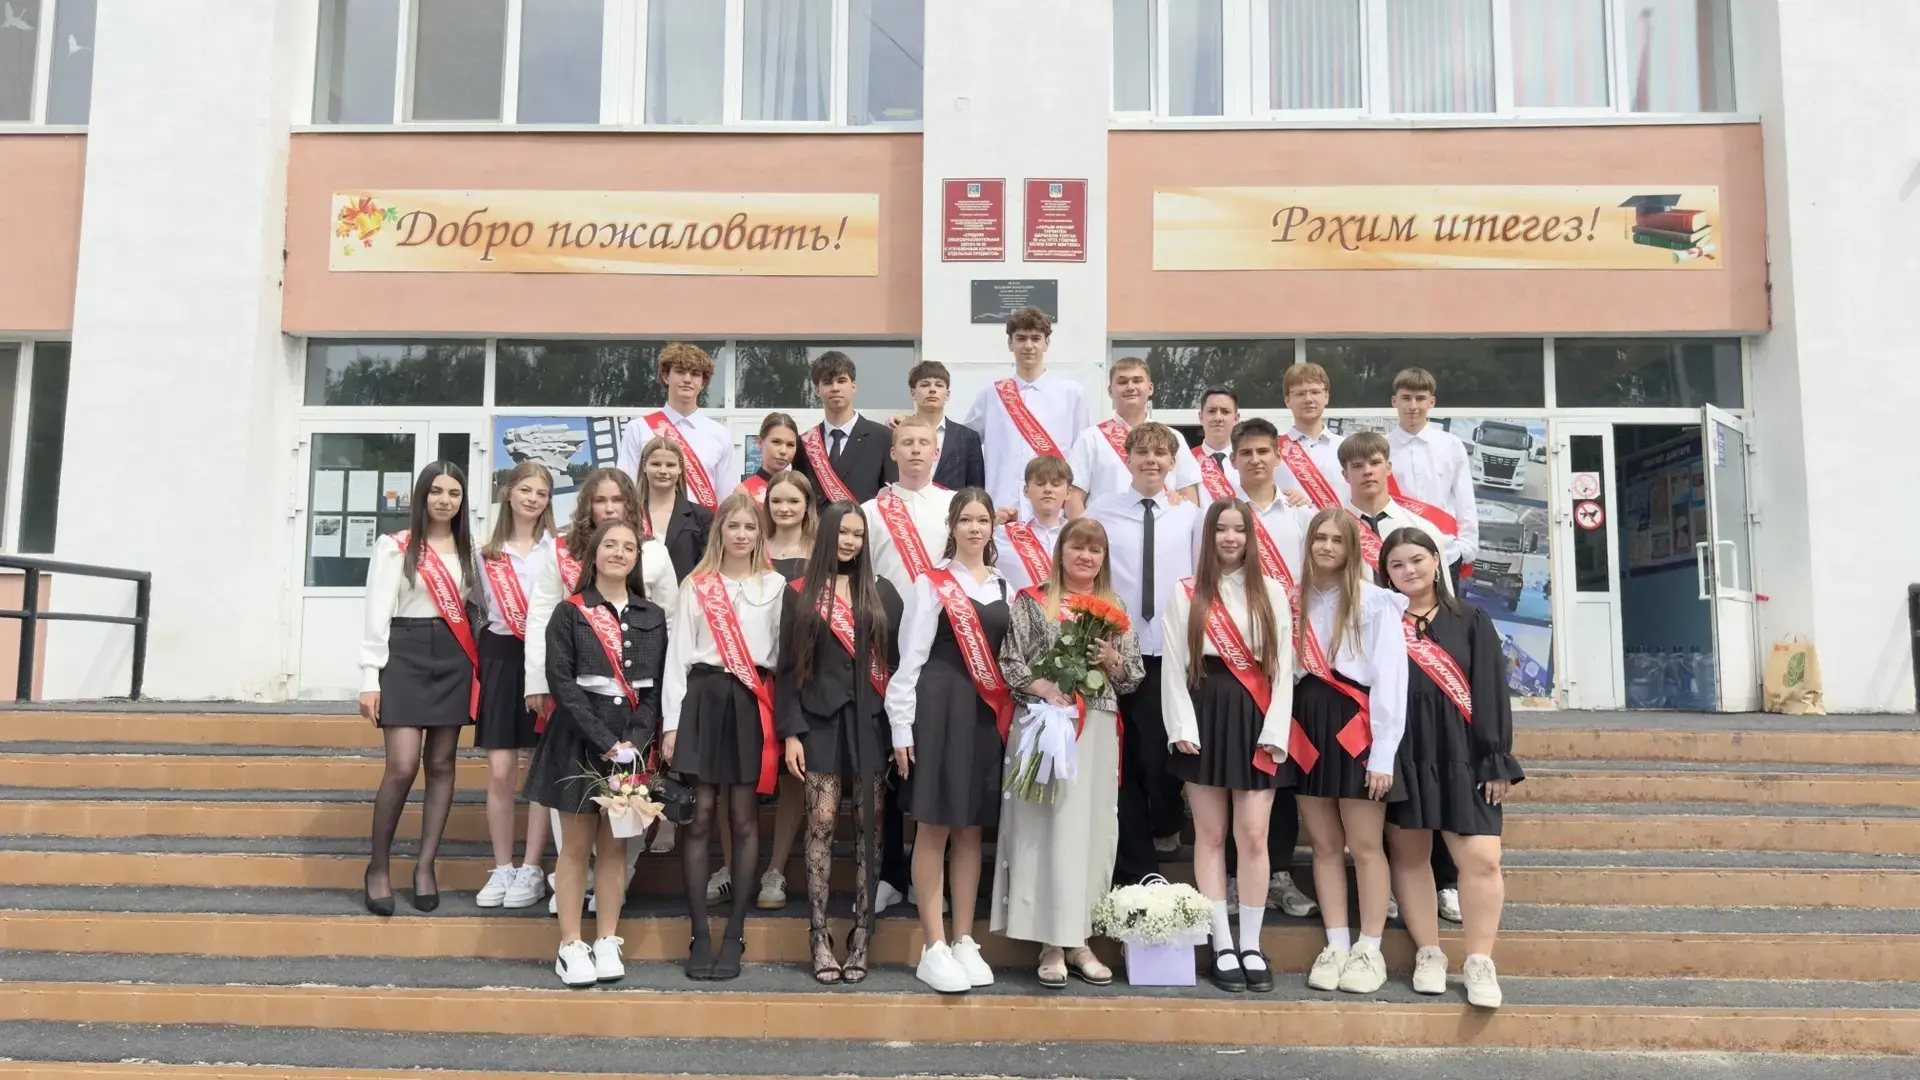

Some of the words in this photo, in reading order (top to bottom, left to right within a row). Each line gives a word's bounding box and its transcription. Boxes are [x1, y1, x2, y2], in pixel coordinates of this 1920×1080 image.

[395, 207, 534, 261] Добро
[547, 211, 849, 252] пожаловать!
[1271, 206, 1419, 251] Рәхим
[1433, 206, 1602, 243] итегез!
[1031, 433, 1052, 452] 2026
[806, 442, 835, 487] Выпускник
[830, 487, 847, 501] 202
[887, 509, 922, 566] Выпускник
[704, 596, 742, 664] Выпускница
[946, 598, 986, 671] Выпускница
[1226, 648, 1252, 671] 2026
